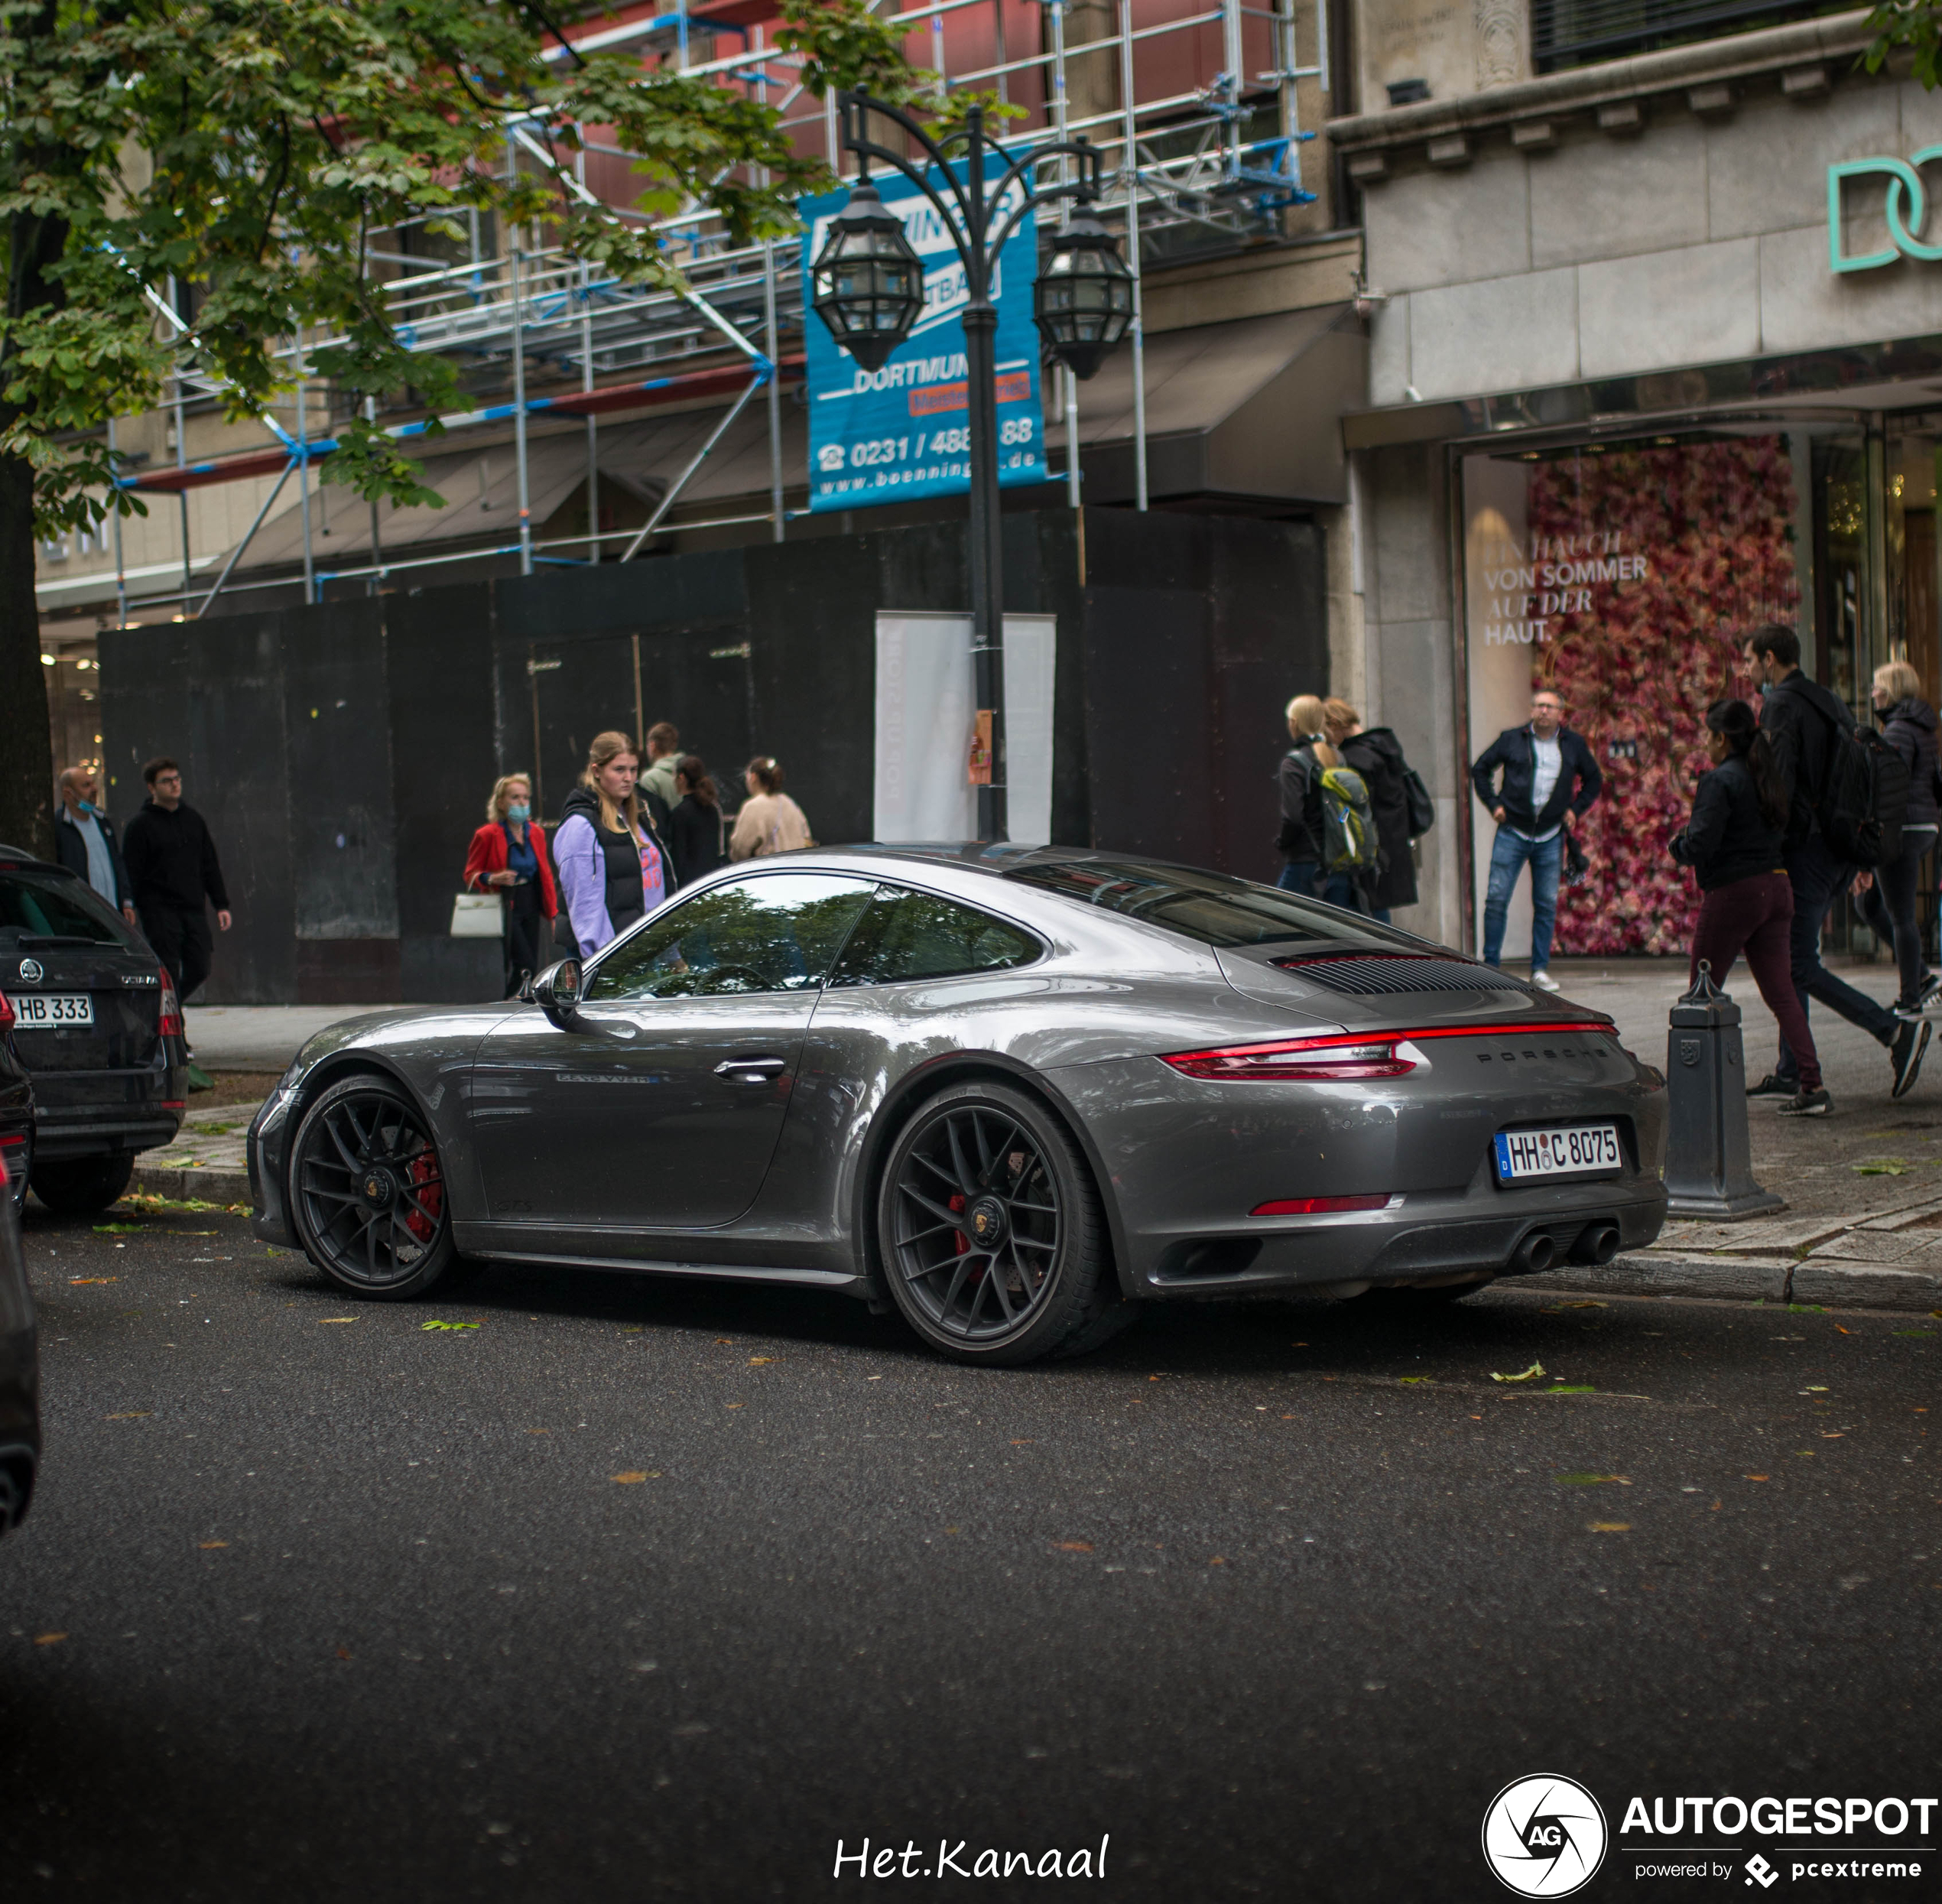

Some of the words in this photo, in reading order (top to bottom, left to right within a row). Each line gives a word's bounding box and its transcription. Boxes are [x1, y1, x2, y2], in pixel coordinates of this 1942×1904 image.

[853, 353, 969, 394] DORTMUN
[850, 436, 909, 467] 0231
[820, 451, 1035, 495] www.boenning.de
[1531, 531, 1622, 560] HAUCH
[1485, 567, 1535, 591] VON
[1542, 555, 1648, 587] SOMMER
[1486, 595, 1537, 619] AUF
[1541, 590, 1593, 616] DER
[1484, 620, 1552, 647] HAUT.
[18, 999, 47, 1021] HB
[50, 998, 89, 1019] 333
[1476, 1048, 1608, 1064] PORSCHE
[1509, 1136, 1540, 1171] HH
[1551, 1134, 1566, 1167] C
[1569, 1129, 1617, 1165] 8075
